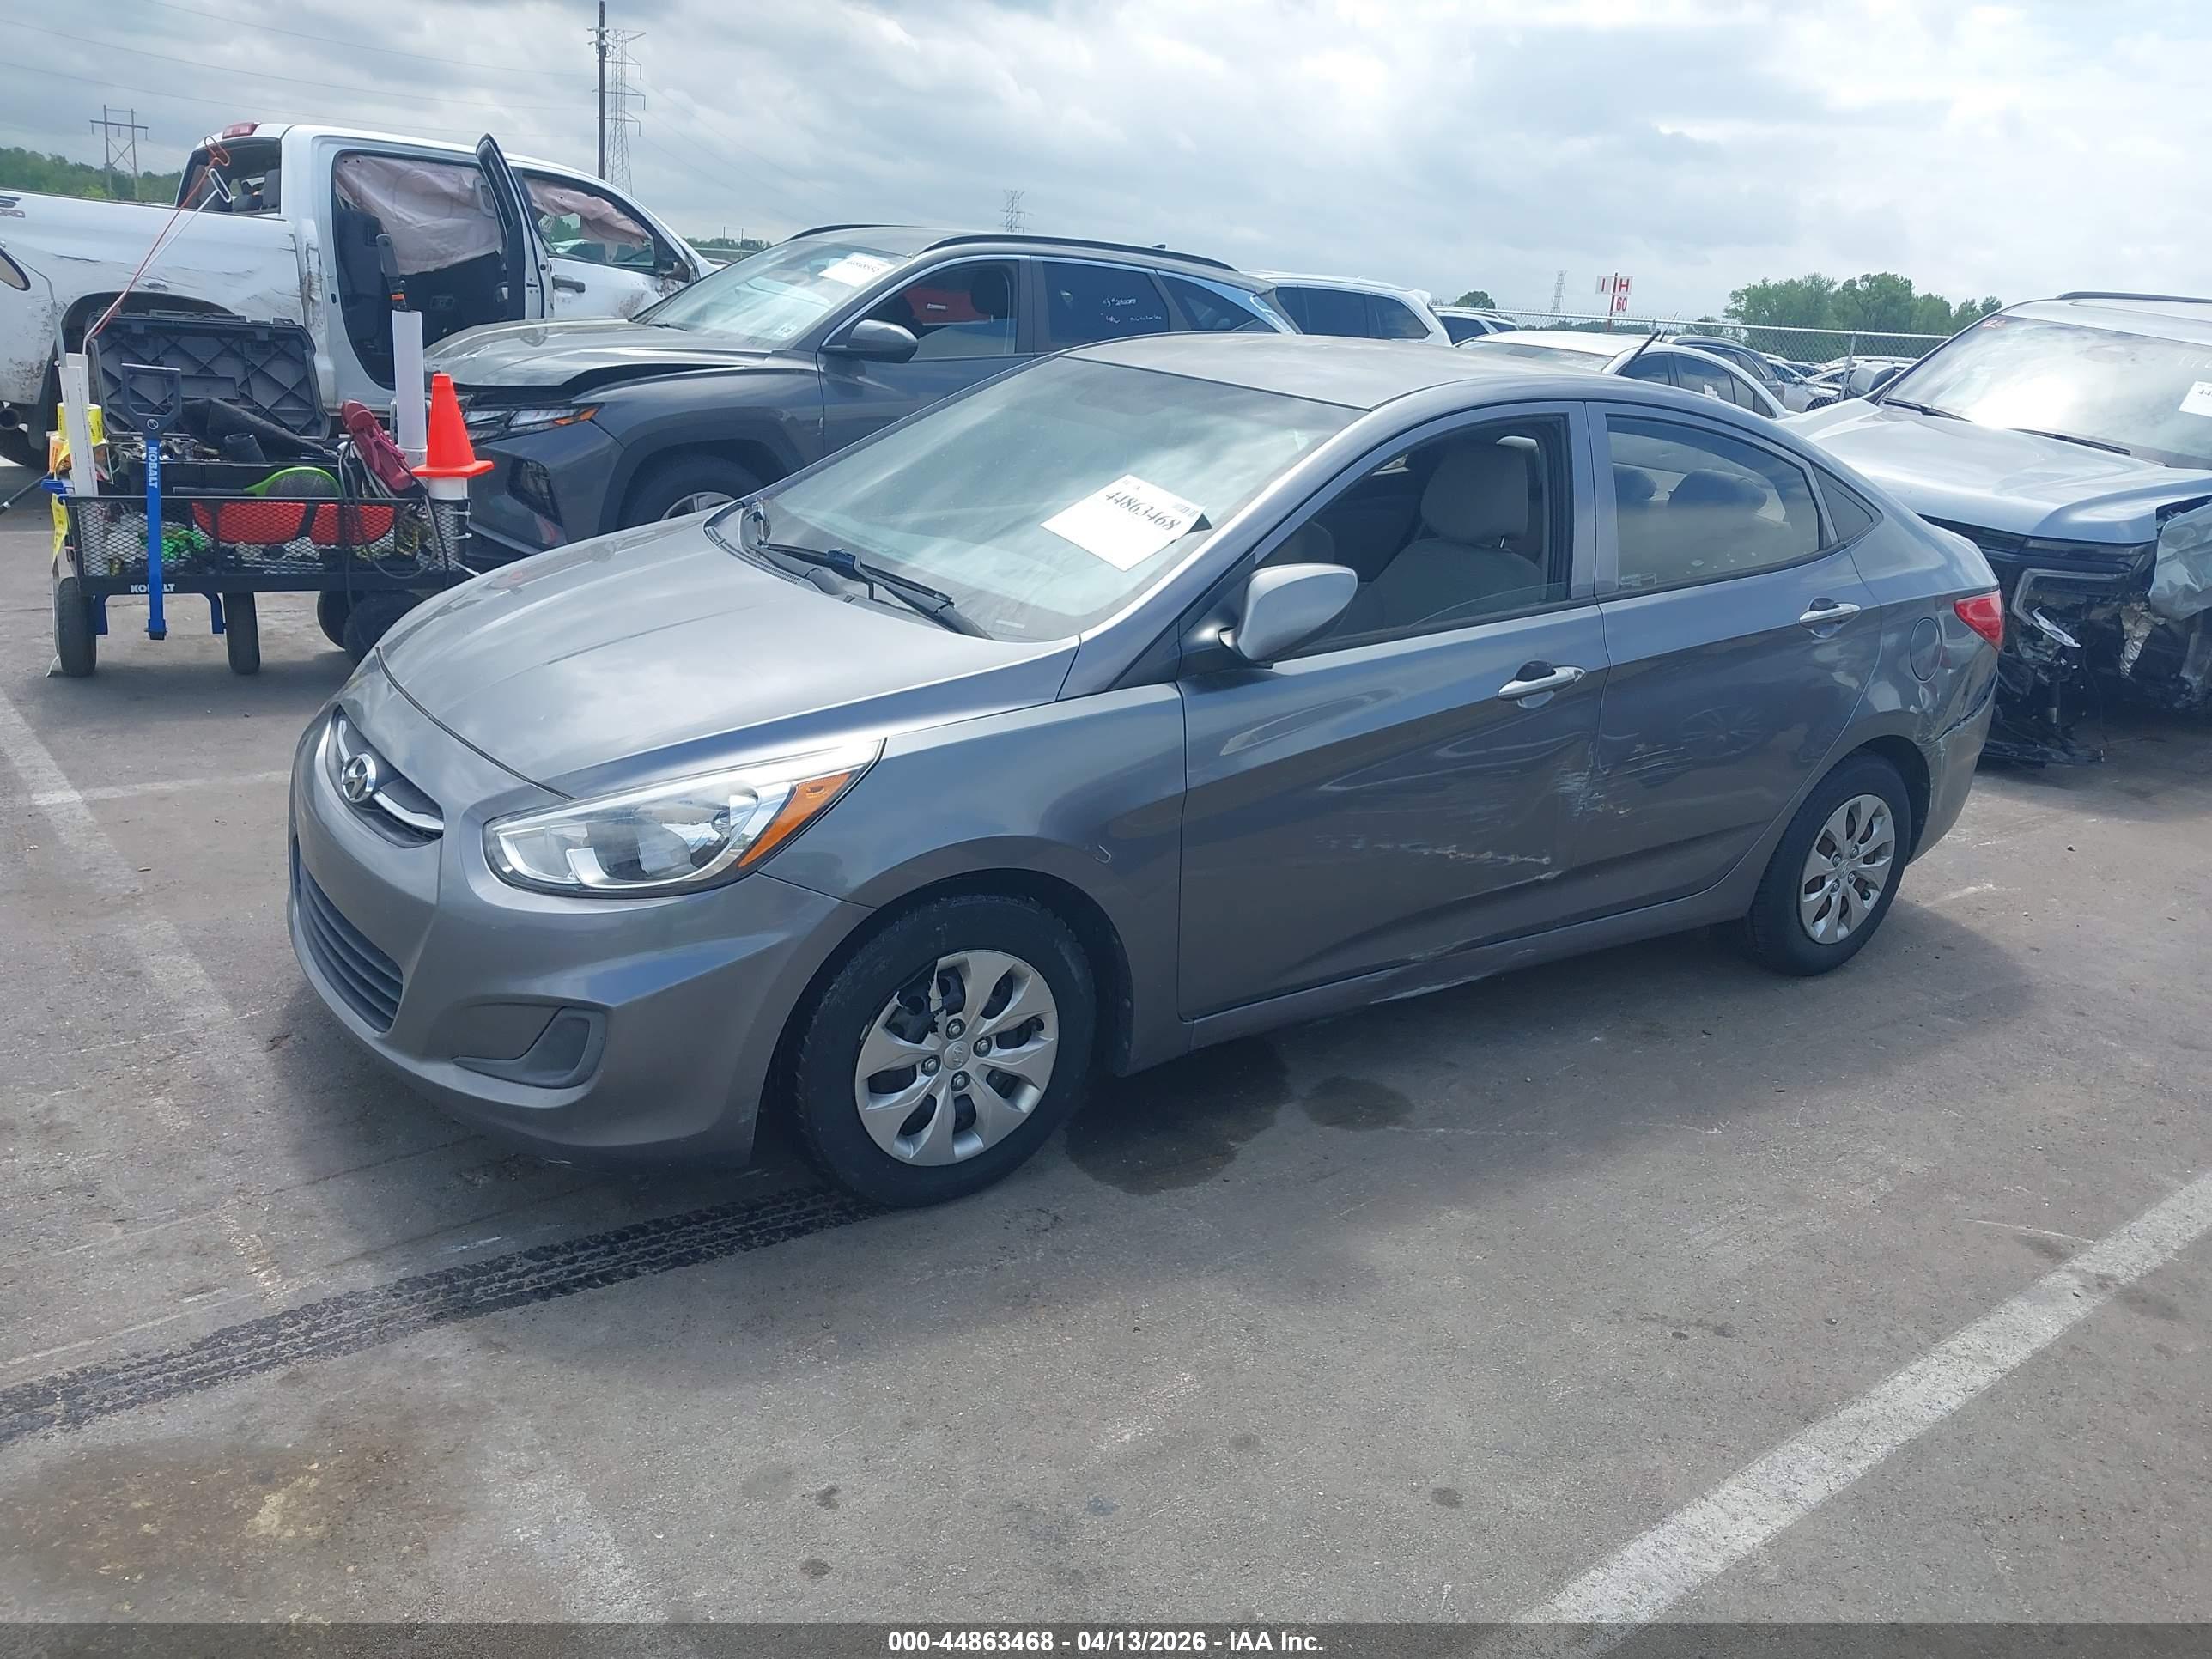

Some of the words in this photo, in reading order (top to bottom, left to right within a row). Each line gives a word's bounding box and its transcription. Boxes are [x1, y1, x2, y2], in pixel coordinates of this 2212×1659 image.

[1619, 278, 1630, 292] H
[1616, 296, 1628, 312] 60
[148, 446, 158, 489] KOBALT
[1105, 491, 1182, 531] 44863468
[130, 583, 176, 593] KOLT
